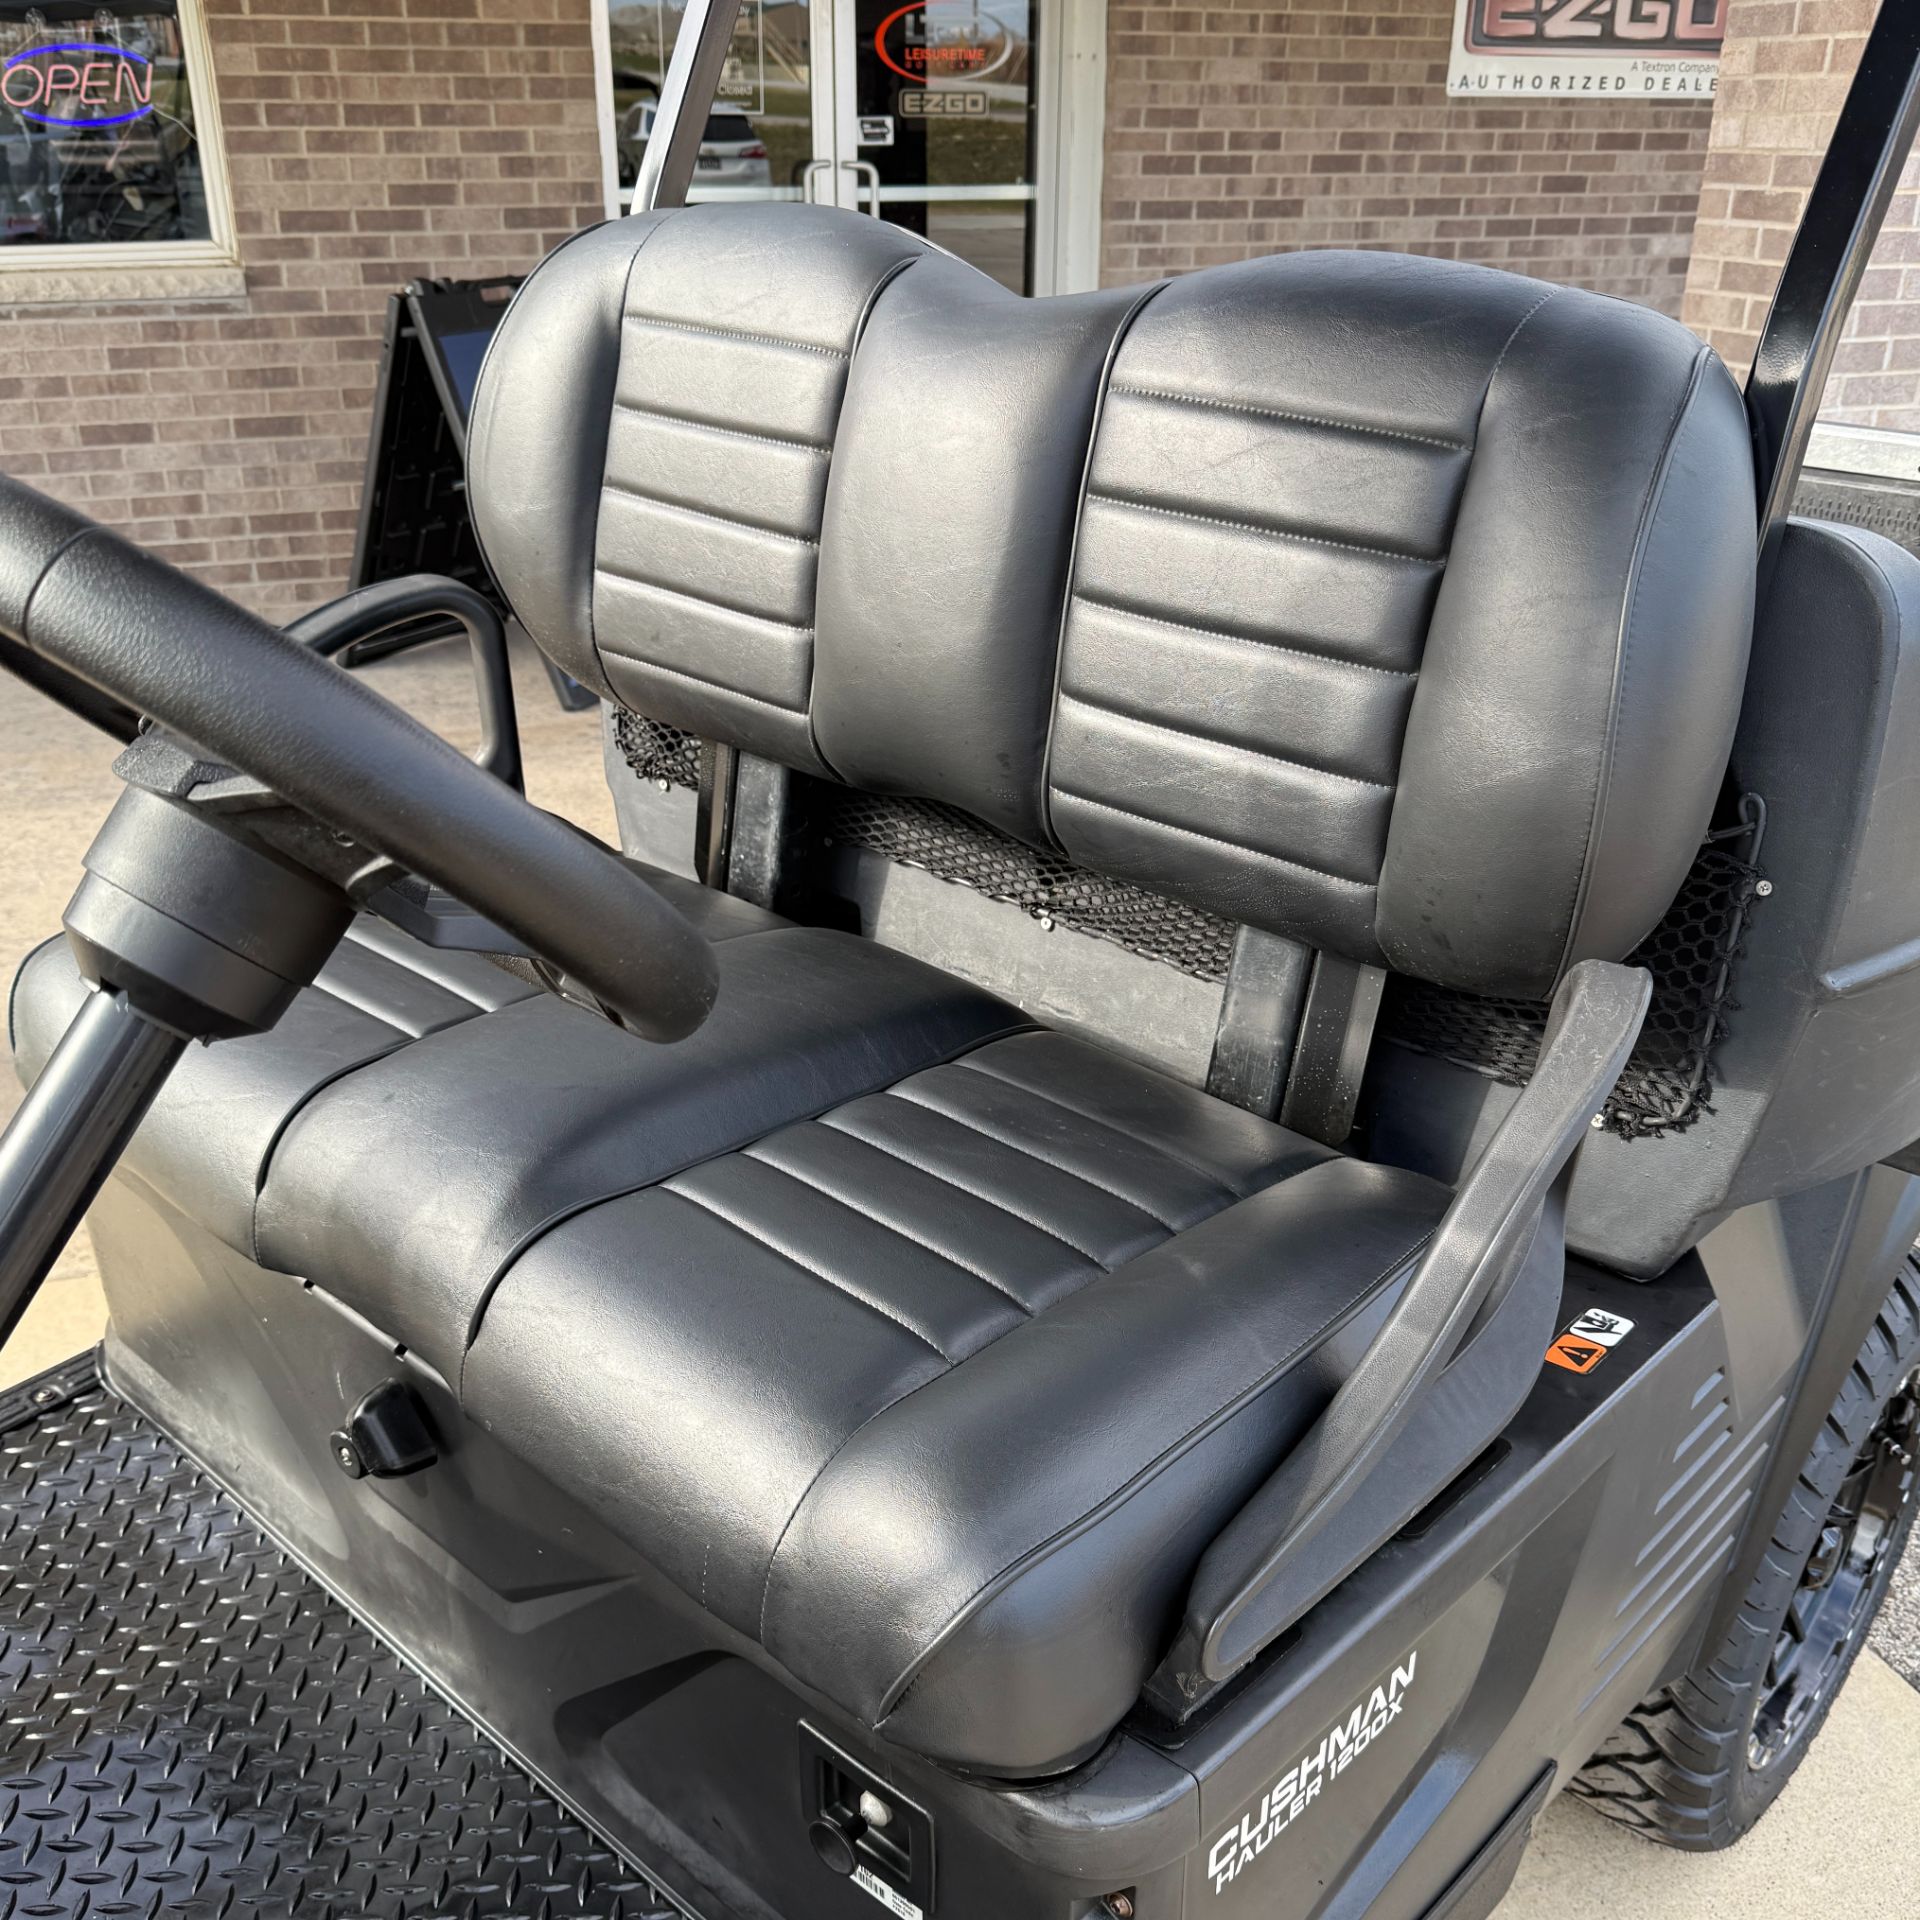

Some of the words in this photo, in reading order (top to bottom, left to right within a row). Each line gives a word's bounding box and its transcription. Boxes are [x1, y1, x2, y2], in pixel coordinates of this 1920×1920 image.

[904, 48, 986, 61] LEISURETIME
[1631, 61, 1639, 72] A
[1642, 61, 1676, 73] Textron
[1, 63, 152, 107] OPEN
[1459, 75, 1626, 91] AUTHORIZED
[1644, 77, 1718, 91] DEALE
[1208, 1650, 1417, 1880] CUSHMAN
[1215, 1774, 1323, 1895] HAULER
[1329, 1692, 1405, 1781] 1200X
